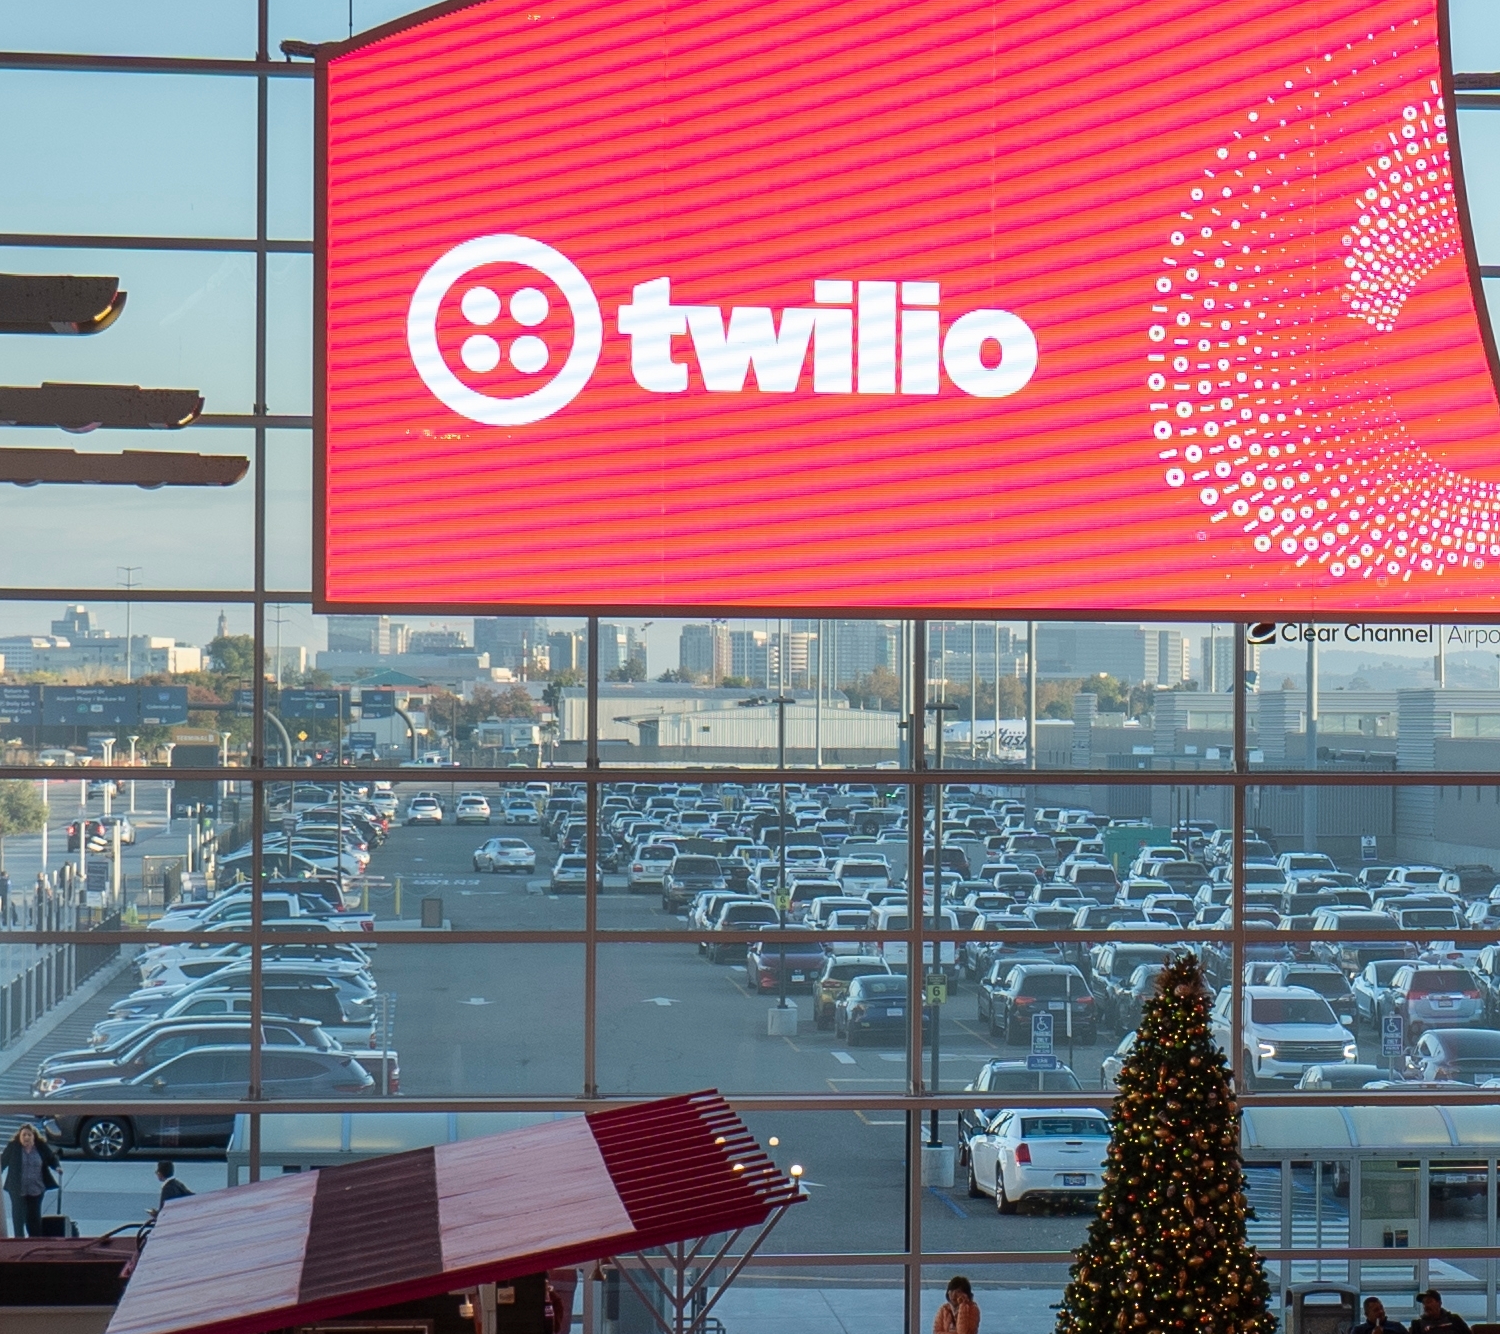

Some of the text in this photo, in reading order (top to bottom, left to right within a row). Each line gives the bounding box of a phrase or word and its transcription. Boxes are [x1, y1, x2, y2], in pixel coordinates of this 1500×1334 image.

[618, 277, 1038, 397] twilio
[1281, 624, 1339, 642] Clear
[1344, 624, 1433, 643] Channel
[780, 895, 786, 904] 6
[932, 986, 940, 996] 6
